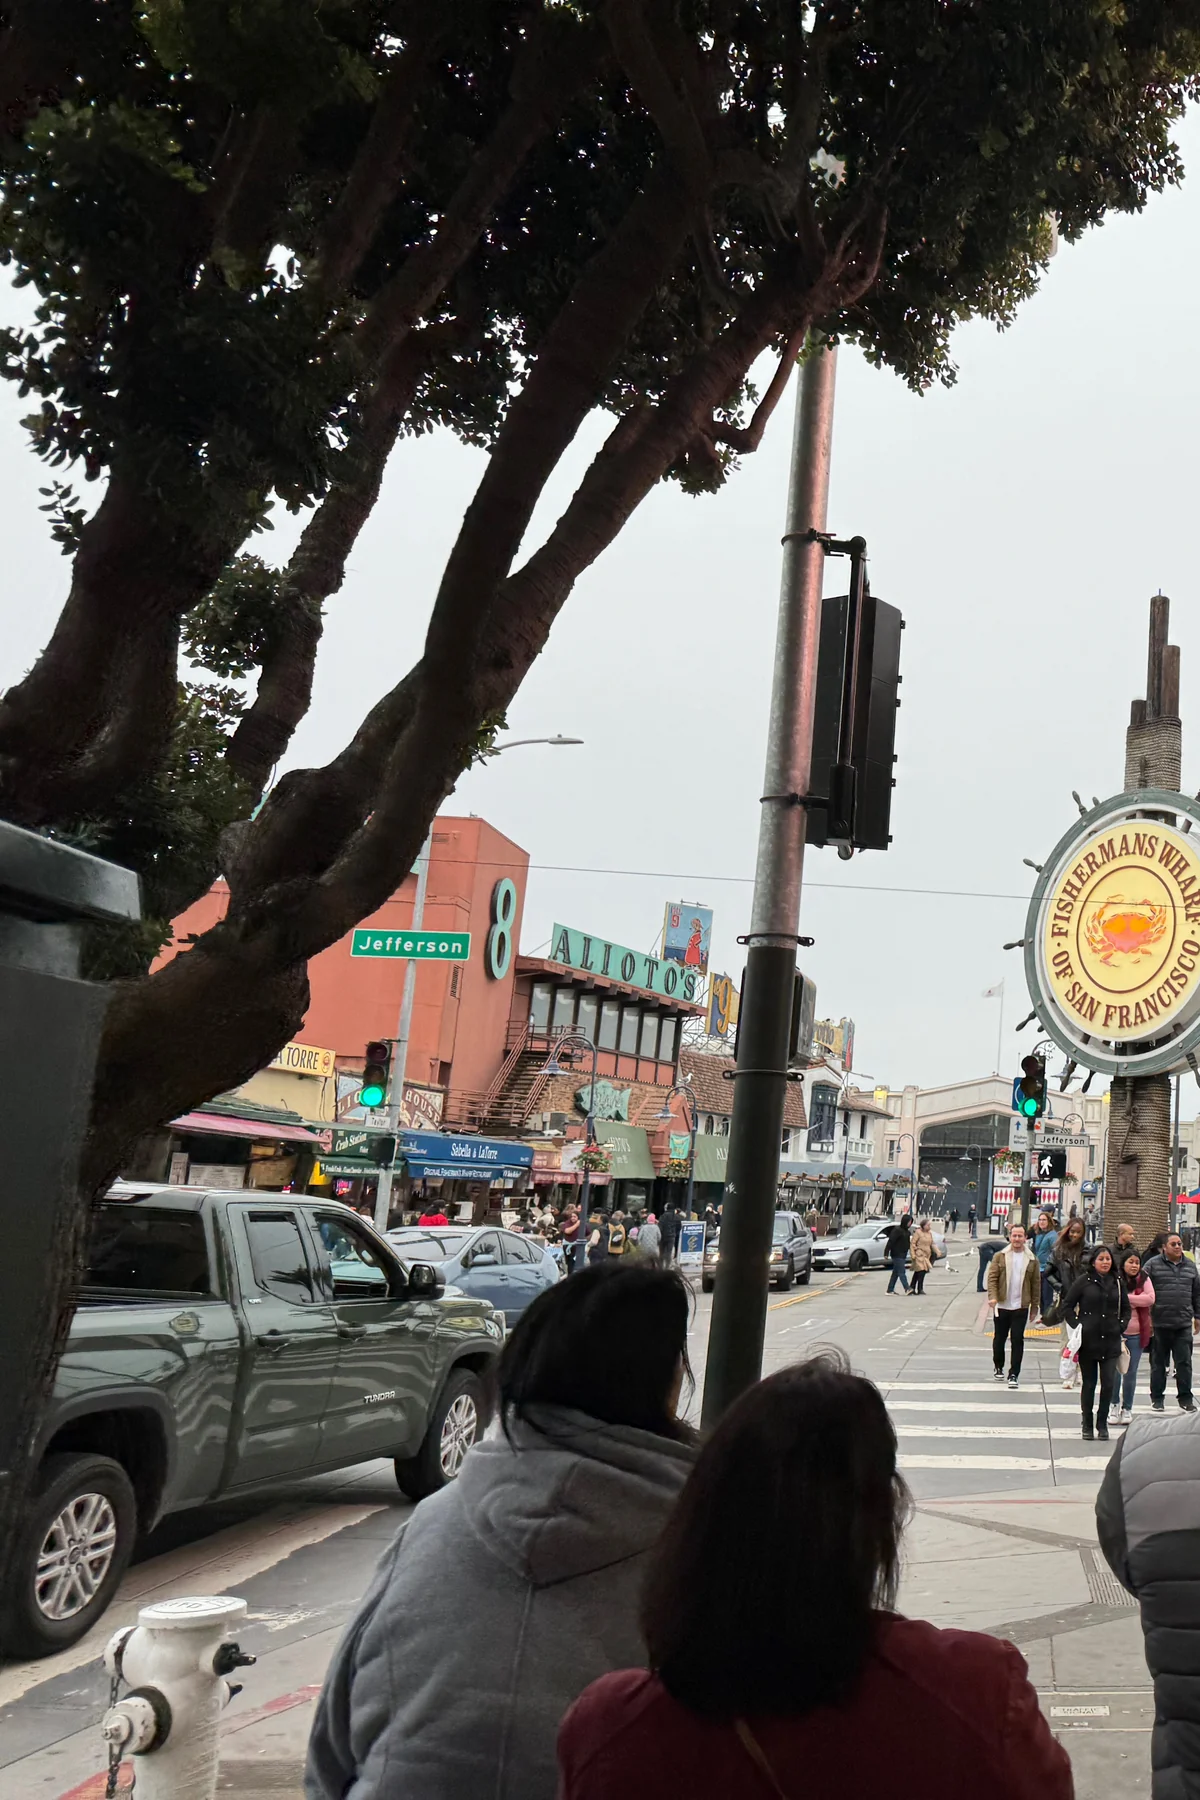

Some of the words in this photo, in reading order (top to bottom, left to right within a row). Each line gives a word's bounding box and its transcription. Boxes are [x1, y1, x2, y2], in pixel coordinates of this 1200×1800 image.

[1051, 832, 1160, 939] FISHERMANS
[487, 877, 517, 979] 8
[359, 936, 462, 954] Jefferson
[553, 928, 696, 1001] ALIOTO'S
[1051, 949, 1075, 980] OF
[1064, 980, 1102, 1022] SAN
[1101, 939, 1200, 1029] FRANCISCO
[286, 1046, 320, 1070] TORRE
[450, 1142, 471, 1159] Sabella
[478, 1144, 498, 1160] LaTorre
[1040, 1135, 1085, 1145] Jefferson
[364, 1390, 396, 1404] TUNDRA
